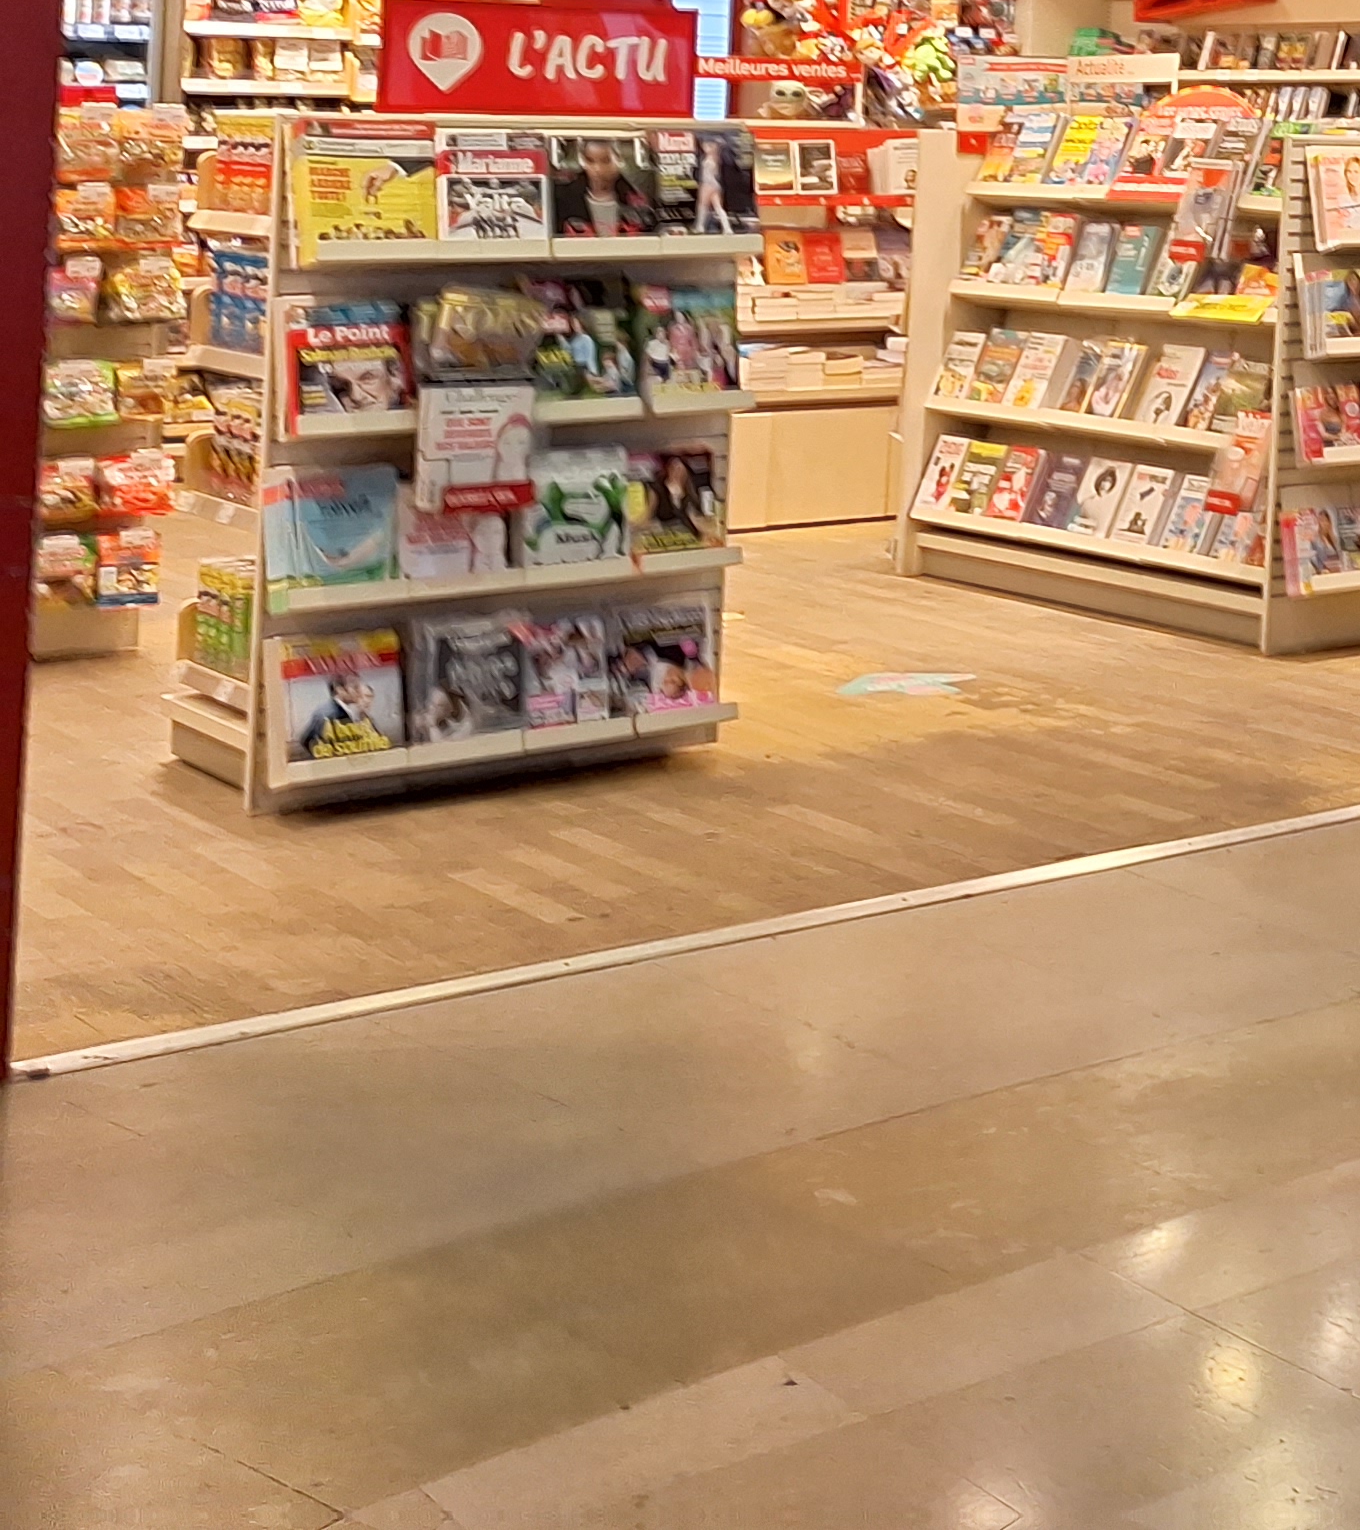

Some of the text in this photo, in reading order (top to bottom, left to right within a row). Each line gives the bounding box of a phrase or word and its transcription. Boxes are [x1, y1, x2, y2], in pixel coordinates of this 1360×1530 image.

[508, 29, 668, 82] L'ACTU
[700, 57, 847, 78] Meilleures ventes
[306, 323, 391, 347] Le Point
